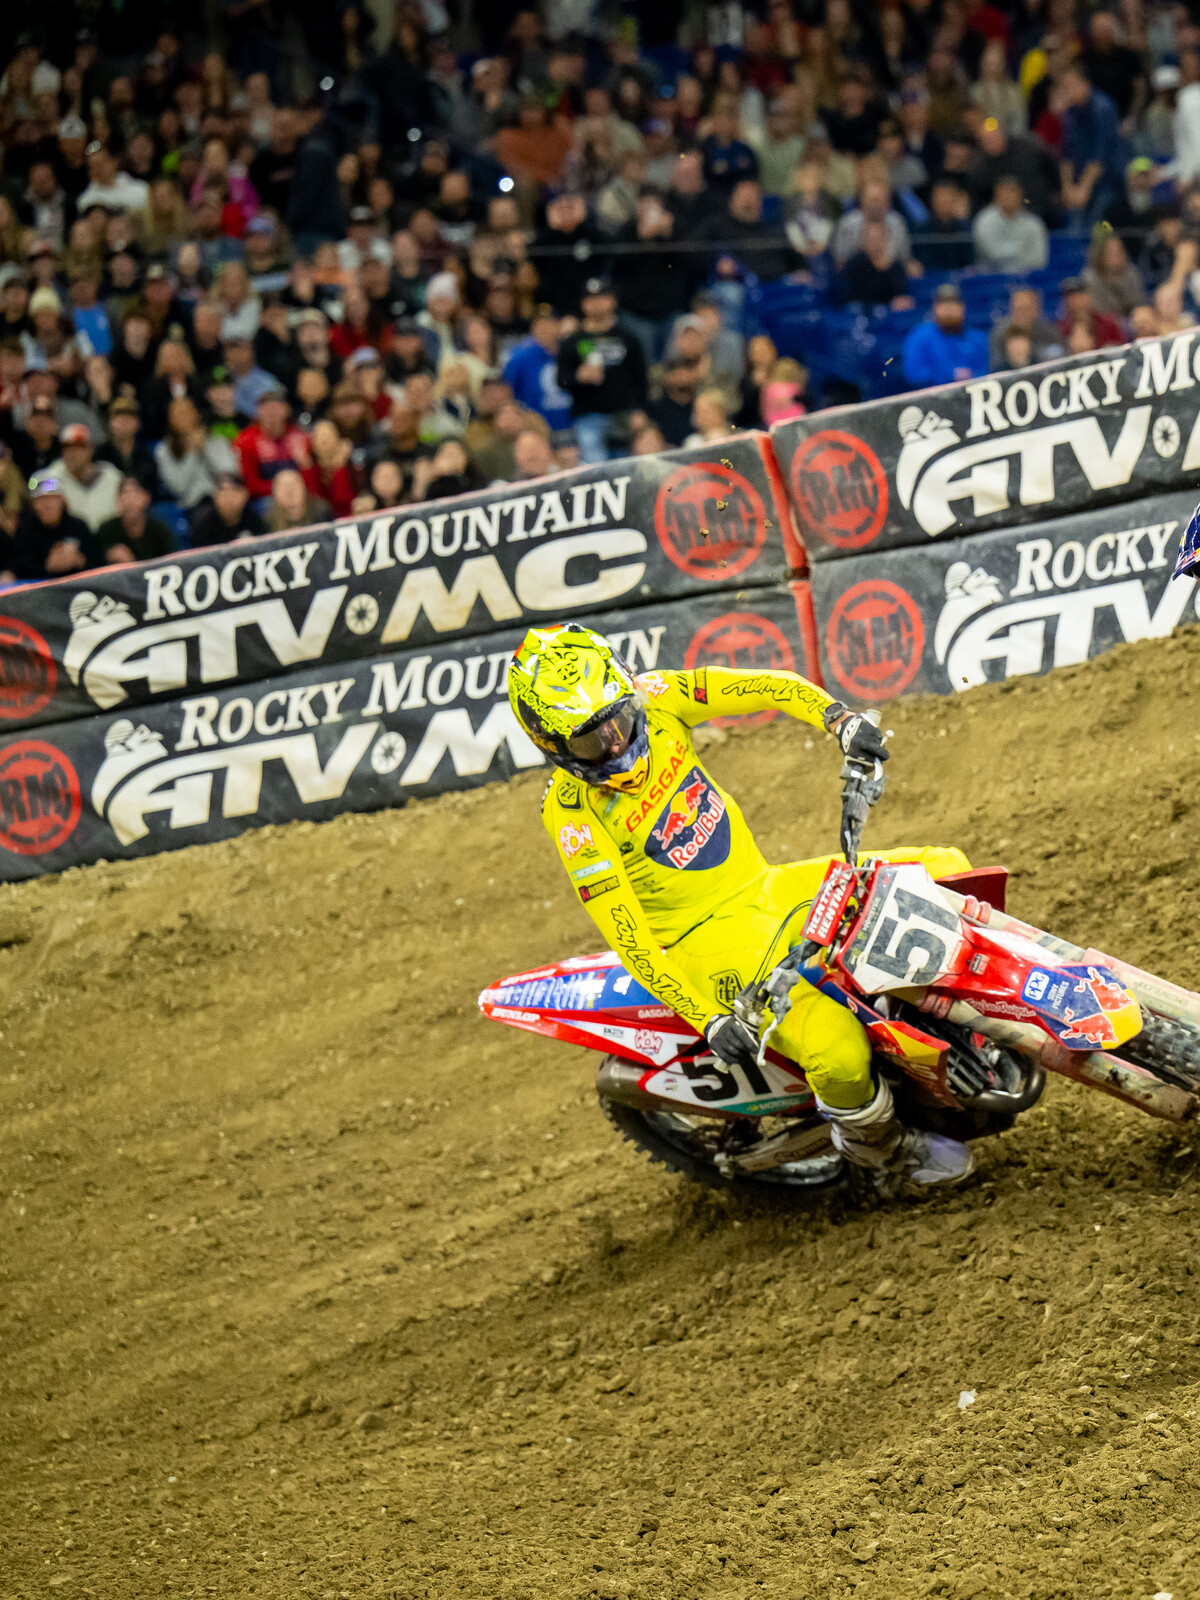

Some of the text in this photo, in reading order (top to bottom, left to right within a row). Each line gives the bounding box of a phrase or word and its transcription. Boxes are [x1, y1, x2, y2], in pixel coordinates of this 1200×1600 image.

[966, 359, 1127, 438] ROCKY
[143, 476, 631, 621] ROCKY MOUNTAIN
[1009, 520, 1179, 598] ROCKY
[174, 678, 356, 751] ROCKY
[626, 741, 687, 833] GASGAS
[668, 791, 725, 869] Red Bull
[626, 949, 655, 982] Lee
[866, 886, 960, 985] 51
[491, 1007, 540, 1023] DUNLOP
[638, 1009, 675, 1019] GASGAS
